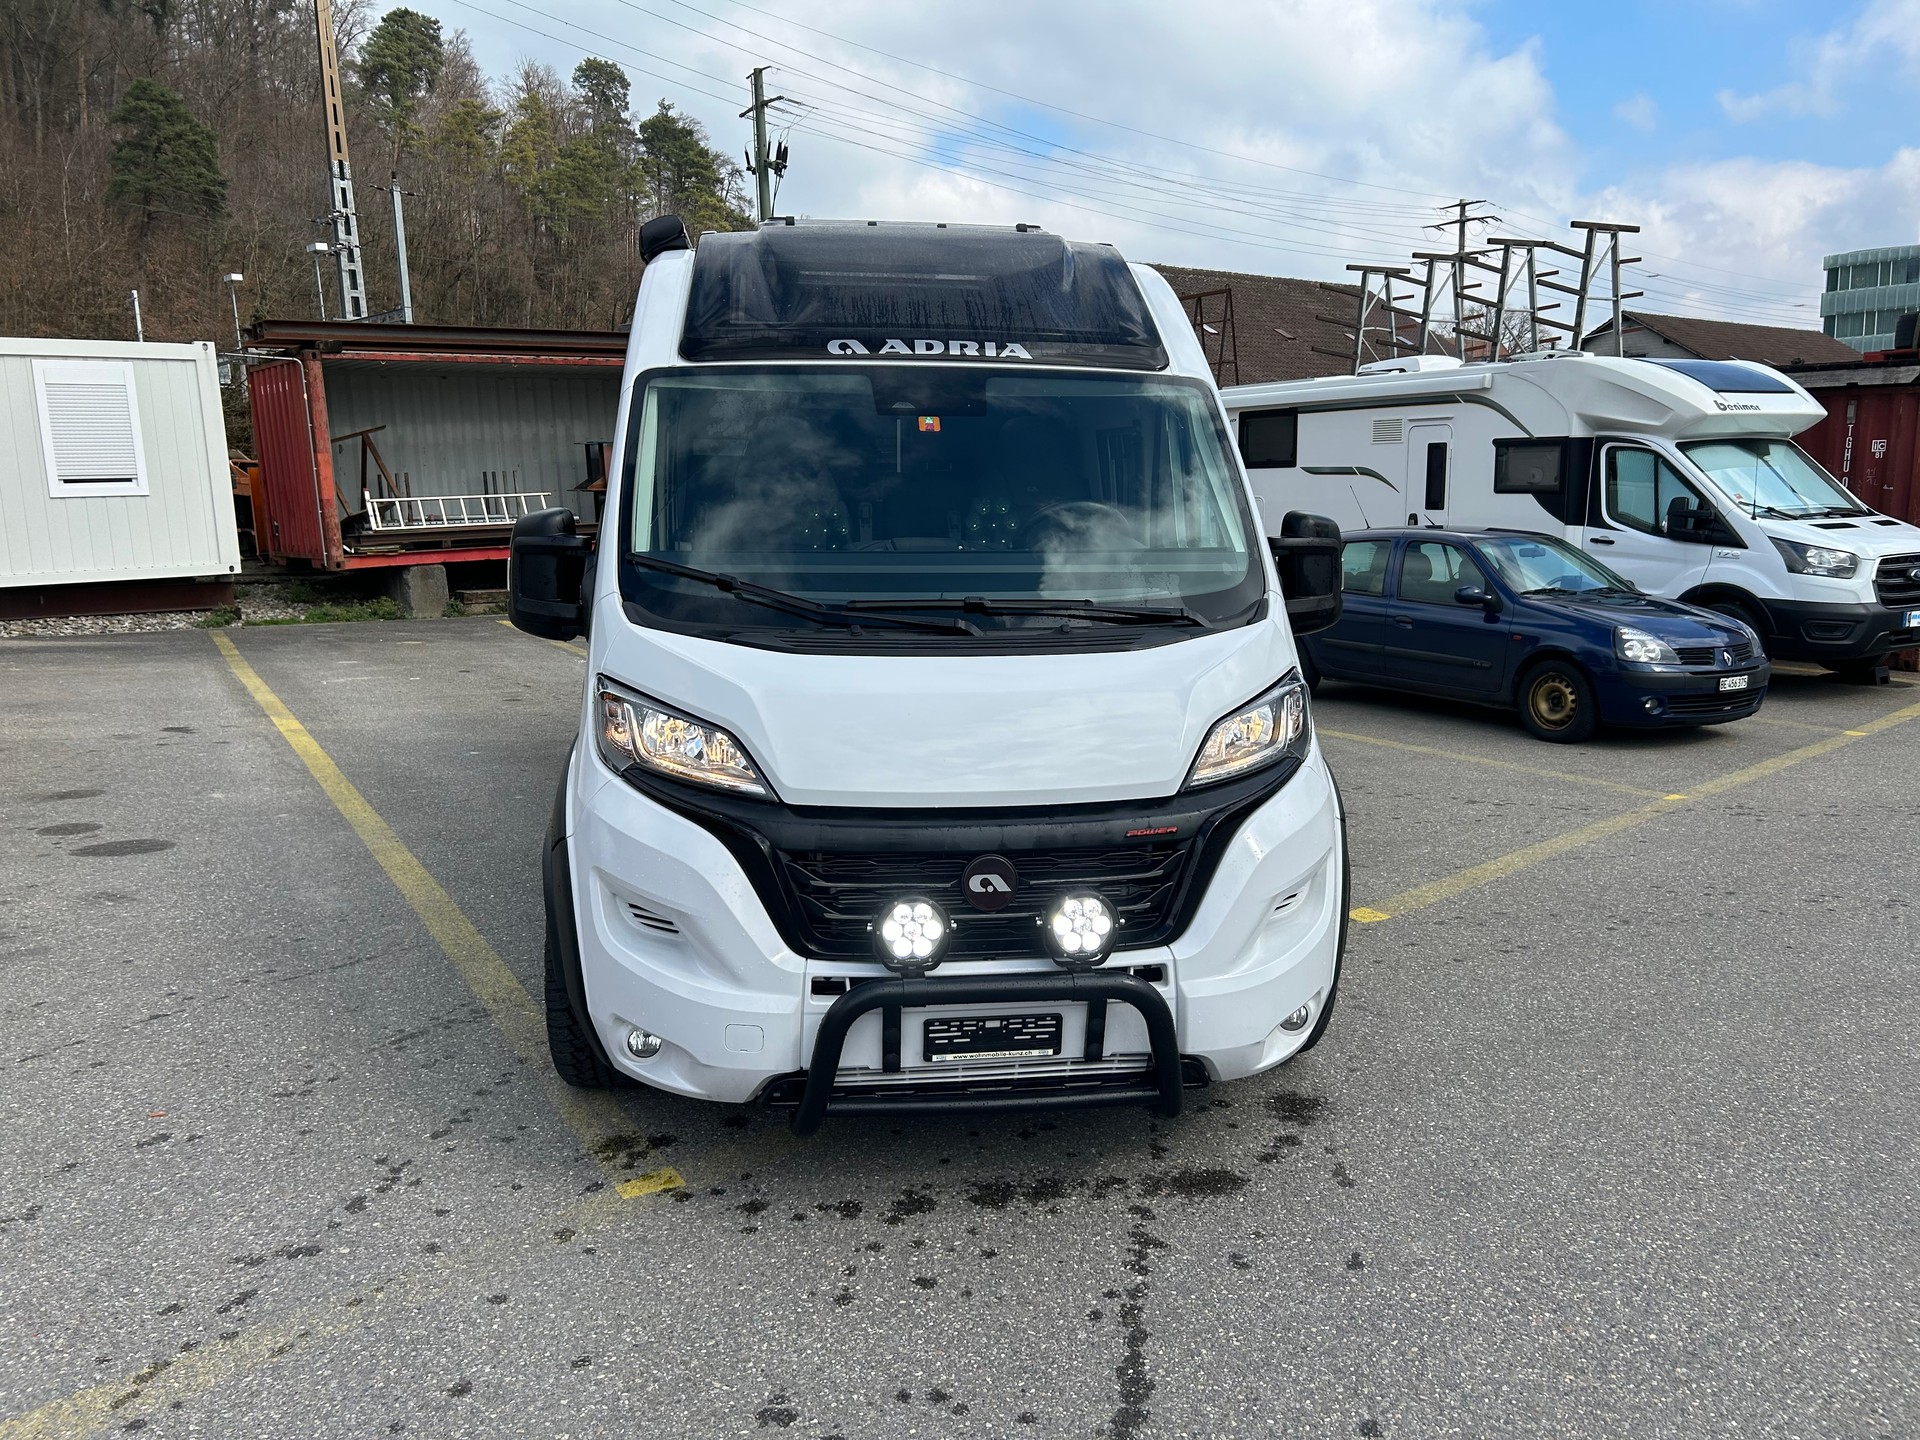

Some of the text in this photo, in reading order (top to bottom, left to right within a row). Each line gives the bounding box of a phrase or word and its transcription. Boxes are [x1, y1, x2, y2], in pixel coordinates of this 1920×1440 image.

[878, 338, 1033, 359] ADRIA
[1843, 424, 1854, 472] TGHU
[1875, 451, 1883, 459] 81
[1720, 680, 1727, 689] BE
[1126, 826, 1178, 837] POWER
[952, 1050, 1033, 1061] www.wohnmobile-kunz.ch
